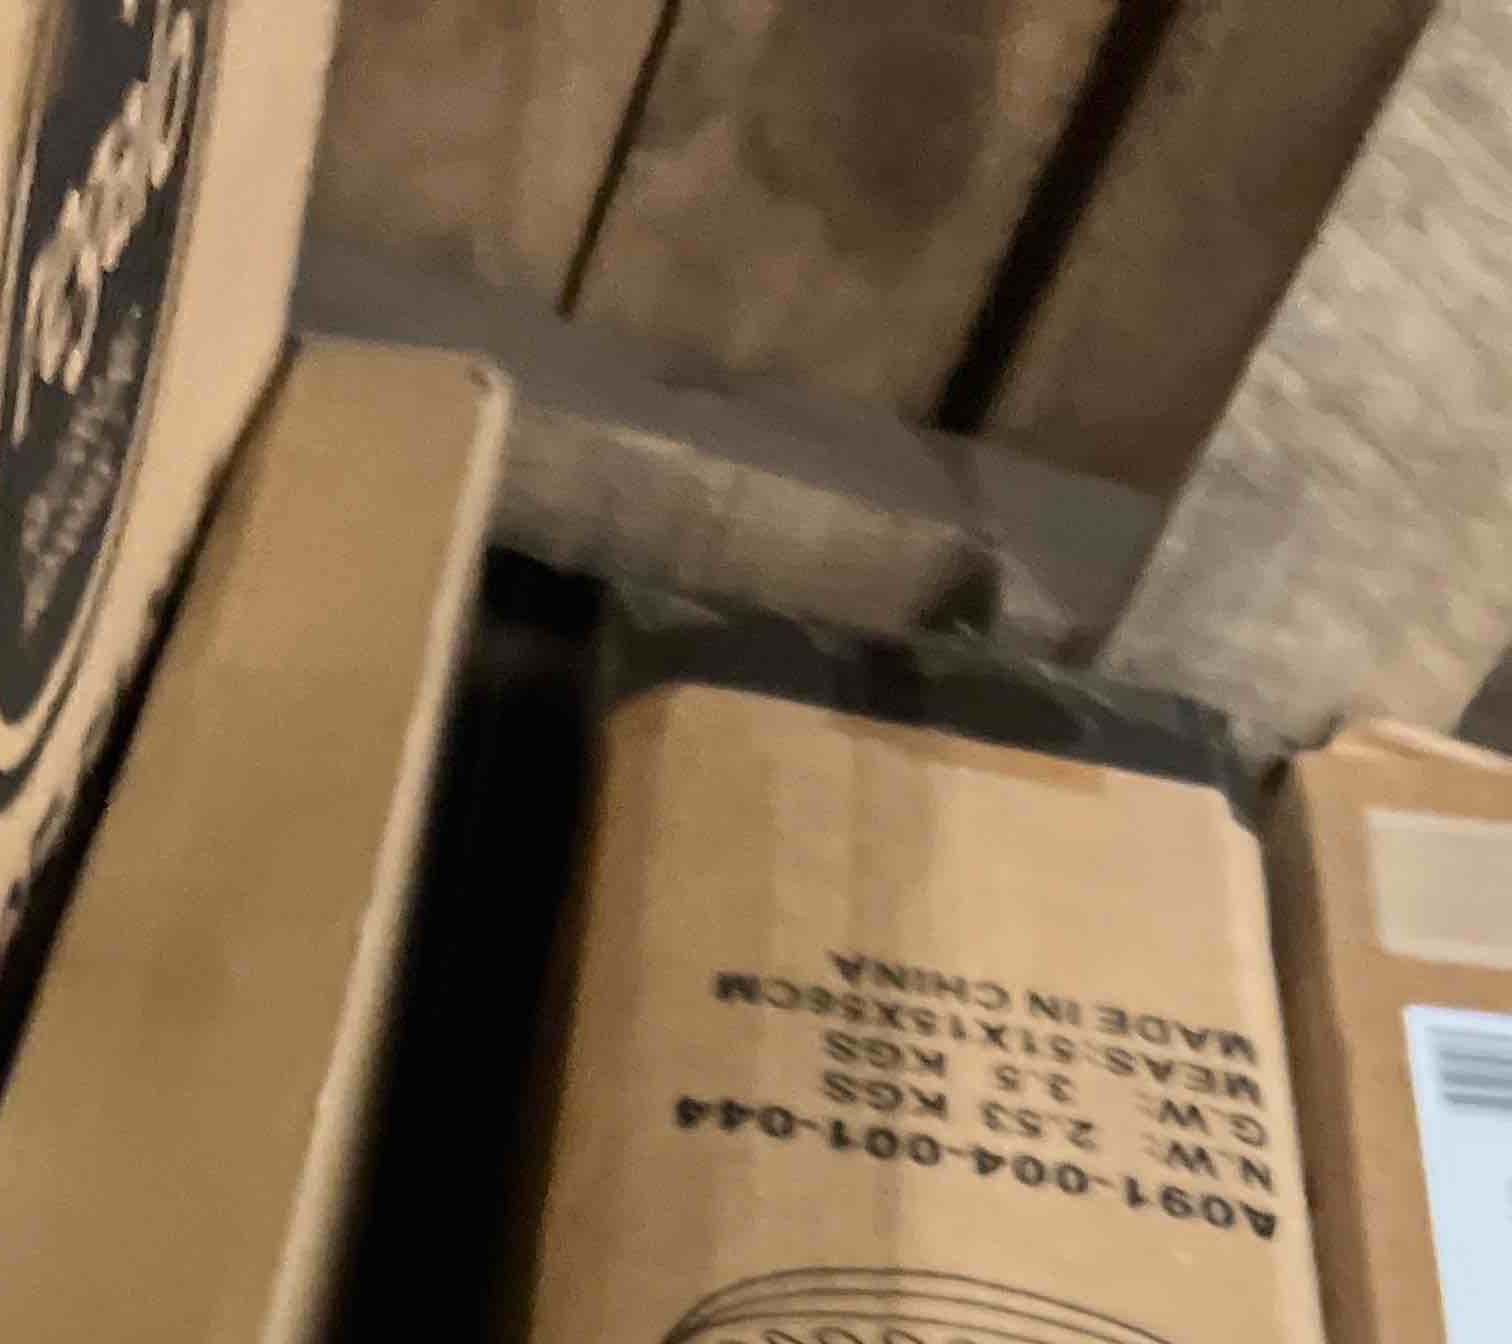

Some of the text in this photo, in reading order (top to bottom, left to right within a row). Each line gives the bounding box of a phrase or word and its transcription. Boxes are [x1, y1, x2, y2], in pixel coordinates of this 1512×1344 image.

[831, 952, 1254, 1059] MADE IN CHINA
[823, 1031, 944, 1074] KGS
[821, 1072, 948, 1120] KGS
[676, 1094, 1276, 1240] A091-004-001-044
